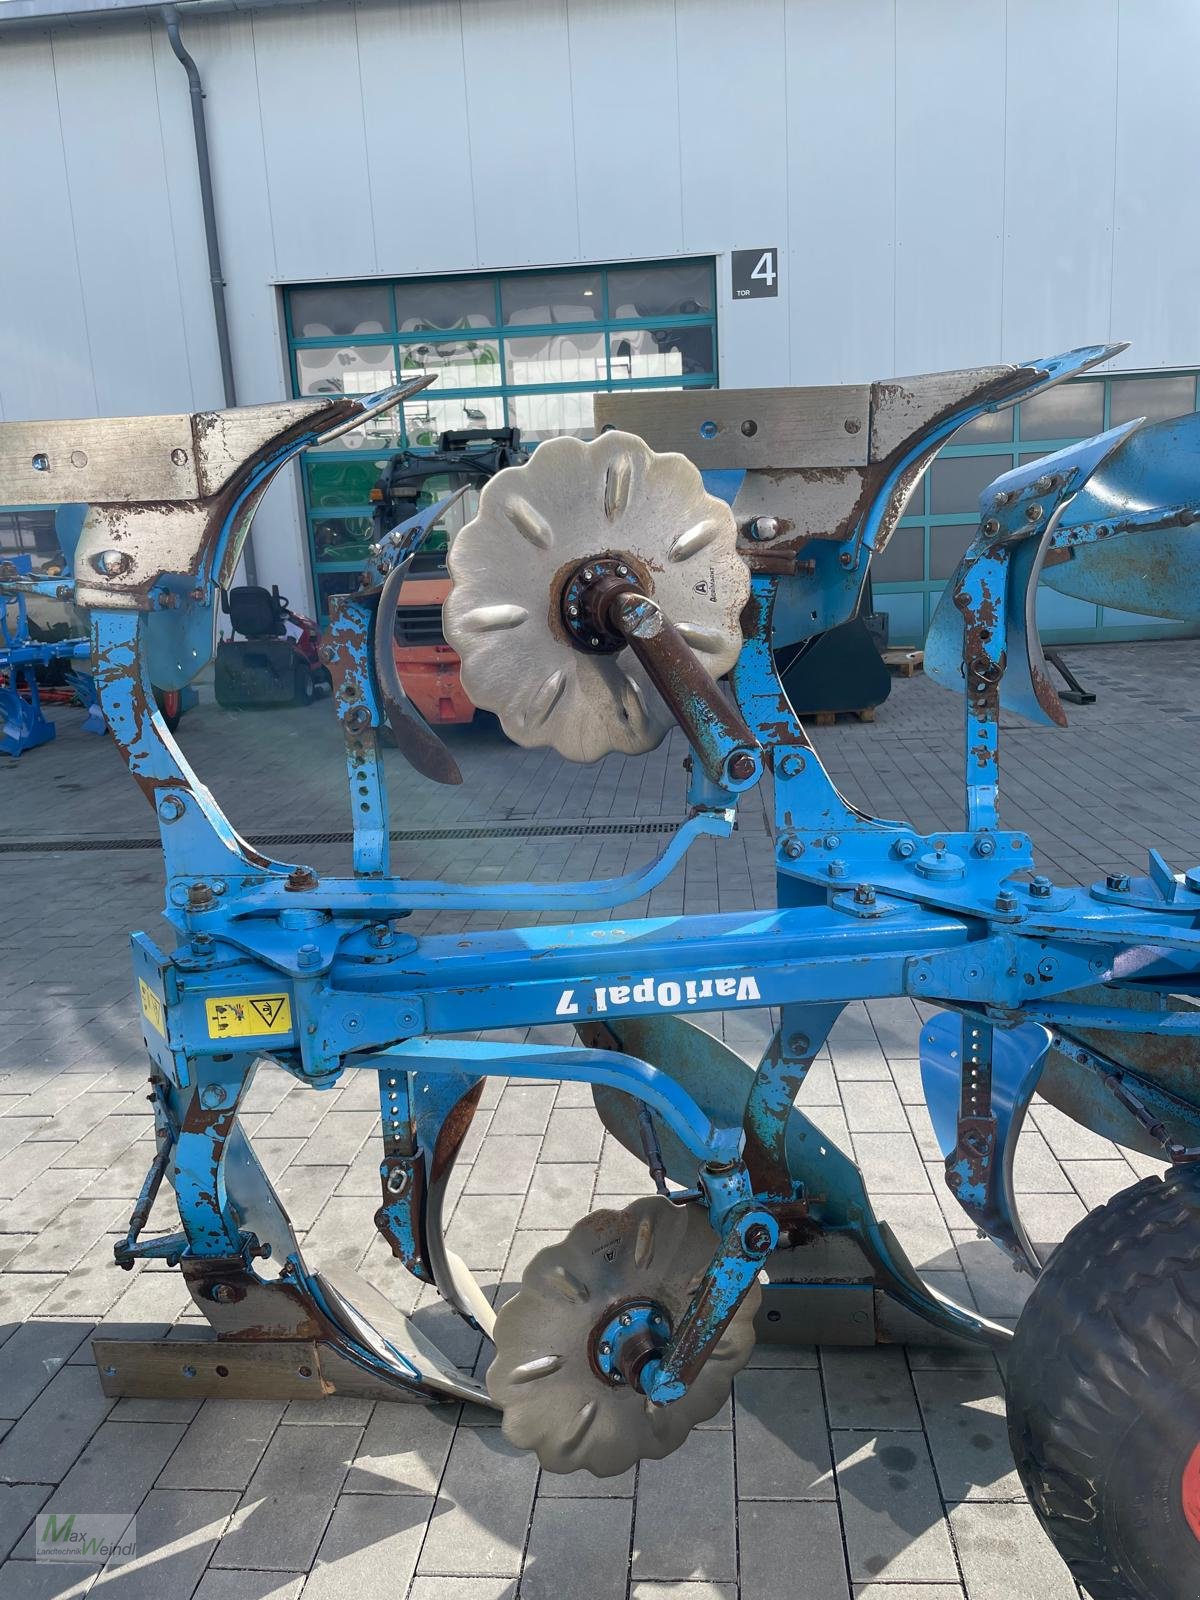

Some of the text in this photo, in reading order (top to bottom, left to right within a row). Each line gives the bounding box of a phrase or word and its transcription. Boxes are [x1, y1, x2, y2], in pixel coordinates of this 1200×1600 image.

[750, 252, 776, 286] 4
[736, 289, 751, 297] TOR
[555, 975, 761, 1015] VariOpal 7
